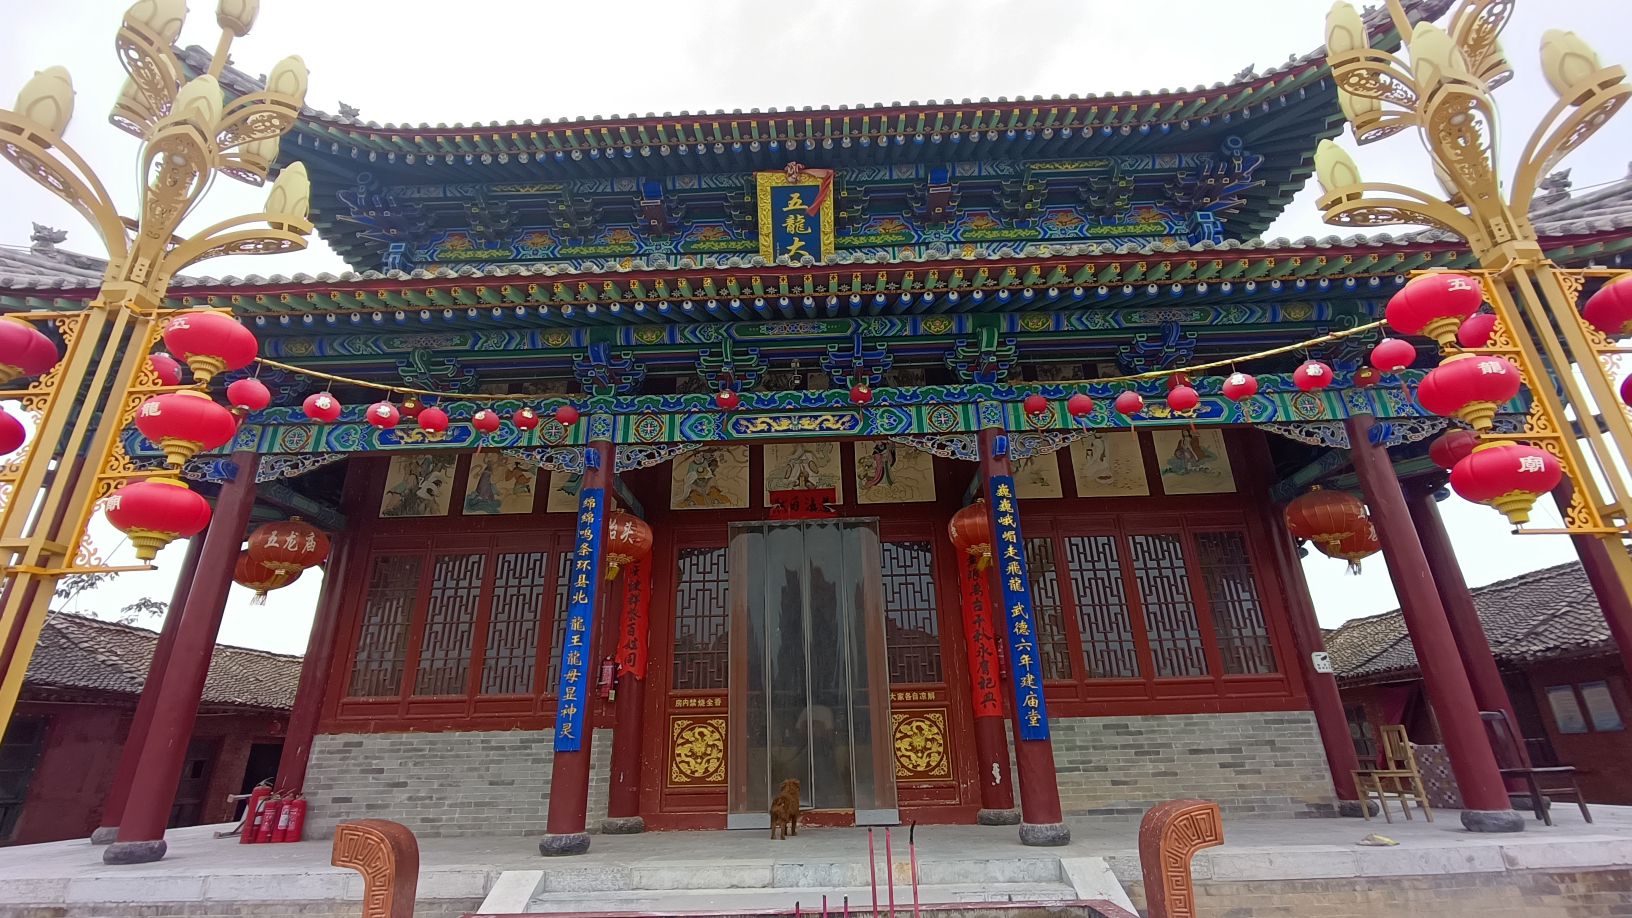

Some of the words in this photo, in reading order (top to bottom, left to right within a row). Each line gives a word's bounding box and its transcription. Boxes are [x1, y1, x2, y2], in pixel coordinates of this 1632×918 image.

[1447, 277, 1472, 292] 五
[168, 317, 190, 331] 五
[1477, 360, 1506, 375] 龍
[140, 401, 162, 418] 龍
